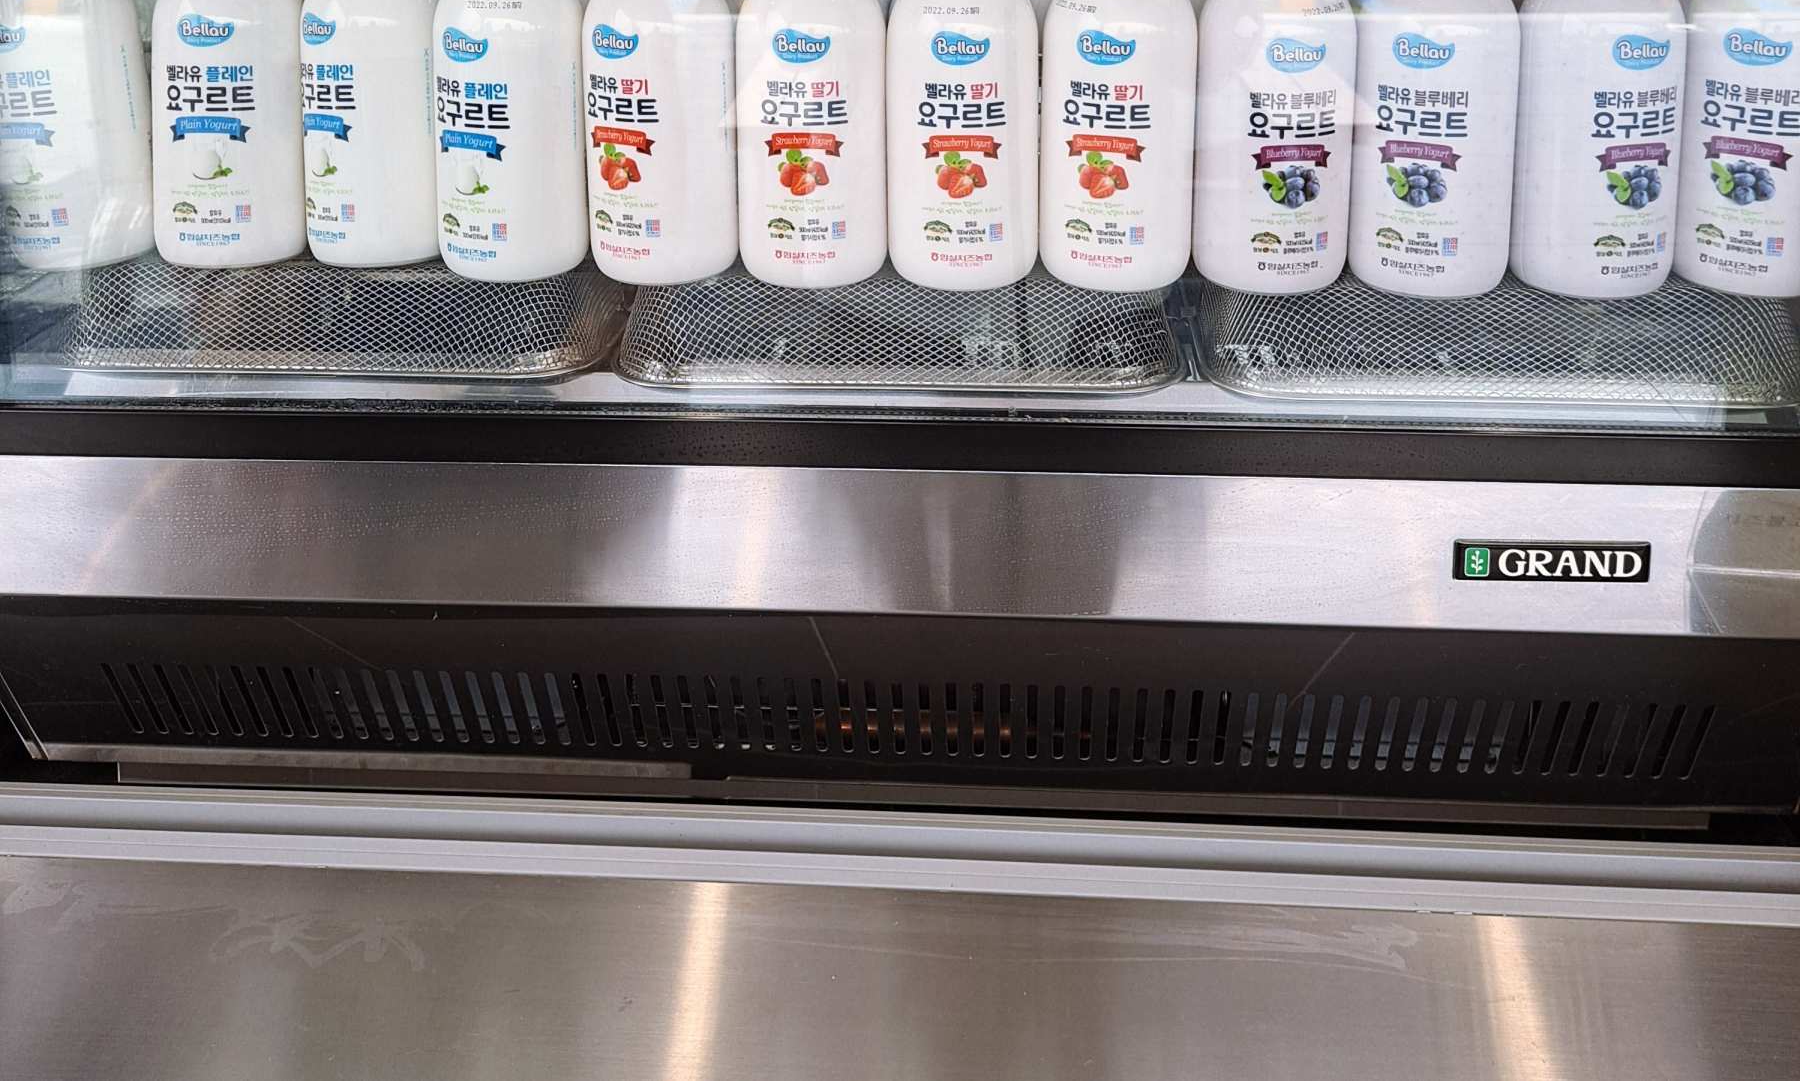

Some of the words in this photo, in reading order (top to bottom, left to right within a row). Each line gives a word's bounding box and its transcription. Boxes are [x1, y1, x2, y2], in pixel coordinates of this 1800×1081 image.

[181, 21, 229, 38] Bellau
[594, 29, 634, 50] Bellau
[444, 32, 483, 53] Bellau
[775, 33, 826, 53] Bellau
[935, 35, 985, 56] Bellau
[1080, 35, 1131, 56] Bellau
[1271, 44, 1322, 62] Bellau
[1396, 38, 1450, 59] Bellau
[1617, 41, 1667, 60] Bellau
[1728, 34, 1787, 58] Bellau
[7, 71, 50, 88] 플레인
[167, 65, 202, 83] 벨라유
[206, 66, 254, 82] 플레인
[316, 65, 353, 81] 플레인
[464, 82, 507, 100] 플레인
[590, 74, 618, 94] 벨라유
[621, 79, 649, 95] 딸기
[767, 81, 807, 99] 벨라유
[811, 81, 840, 98] 딸기
[925, 82, 967, 100] 벨라유
[970, 81, 998, 100] 딸기
[1070, 80, 1110, 101] 벨라유
[1114, 85, 1143, 101] 딸기
[1705, 79, 1742, 103] 벨라유
[167, 86, 255, 112] 요구르트
[1250, 91, 1288, 110] 벨라유
[1291, 89, 1337, 110] 블루베리
[1378, 84, 1412, 106] 벨라유
[1415, 90, 1469, 108] 블루베리
[1594, 91, 1634, 109] 벨라유
[1637, 86, 1677, 107] 블루베리
[437, 96, 510, 129] 요구르트
[588, 95, 659, 123] 요구르트
[760, 99, 848, 127] 요구르트
[918, 101, 1006, 129] 요구르트
[1062, 99, 1151, 129] 요구르트
[1700, 100, 1800, 137] 요구르트
[180, 118, 202, 130] Plain
[203, 119, 238, 133] Yogurt
[1248, 110, 1336, 139] 요구르트
[1376, 105, 1468, 138] 요구르트
[1591, 107, 1676, 139] 요구르트
[463, 135, 493, 149] Yogurt
[775, 135, 811, 147] Strawberry
[932, 138, 969, 149] Strawberry
[970, 138, 991, 149] Yogurt
[1076, 137, 1112, 149] Strawberry
[1390, 143, 1424, 157] Blueberry
[1425, 147, 1450, 159] Yogurt
[1715, 141, 1751, 153] Blueberry
[1752, 145, 1780, 158] Yogurt
[1266, 149, 1300, 159] Blueberry
[1611, 148, 1644, 160] Blueberry
[1498, 549, 1642, 578] GRAND
